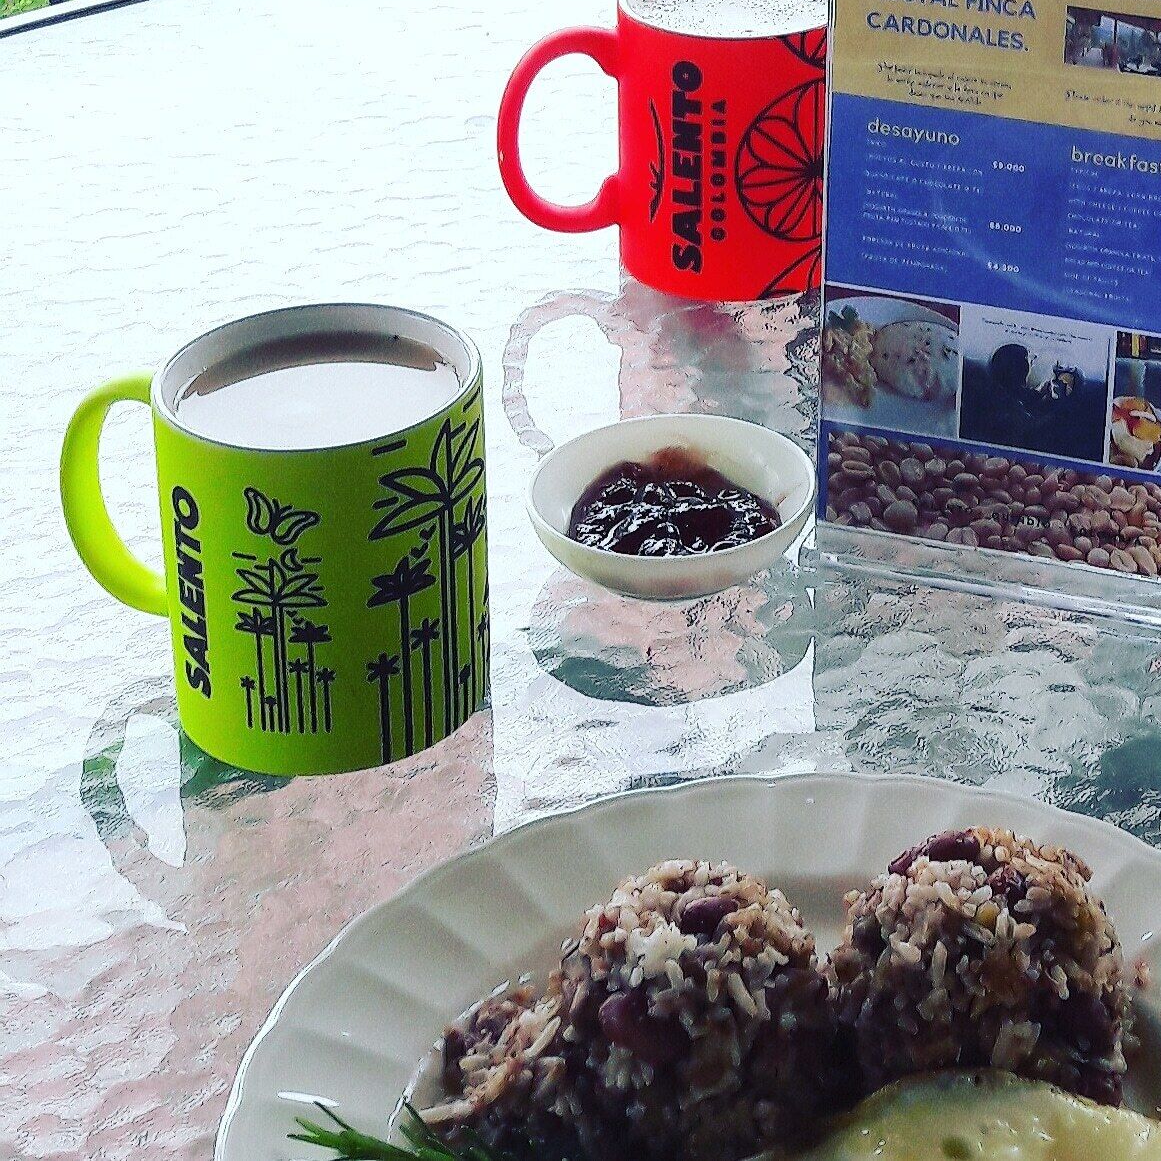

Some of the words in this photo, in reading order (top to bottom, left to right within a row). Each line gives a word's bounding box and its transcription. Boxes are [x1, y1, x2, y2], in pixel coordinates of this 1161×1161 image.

[866, 11, 1030, 52] CARDONALES.
[672, 60, 703, 275] SALENTO
[710, 98, 728, 242] COLOMBIA
[867, 117, 960, 145] desayuno
[172, 485, 211, 699] SALENTO
